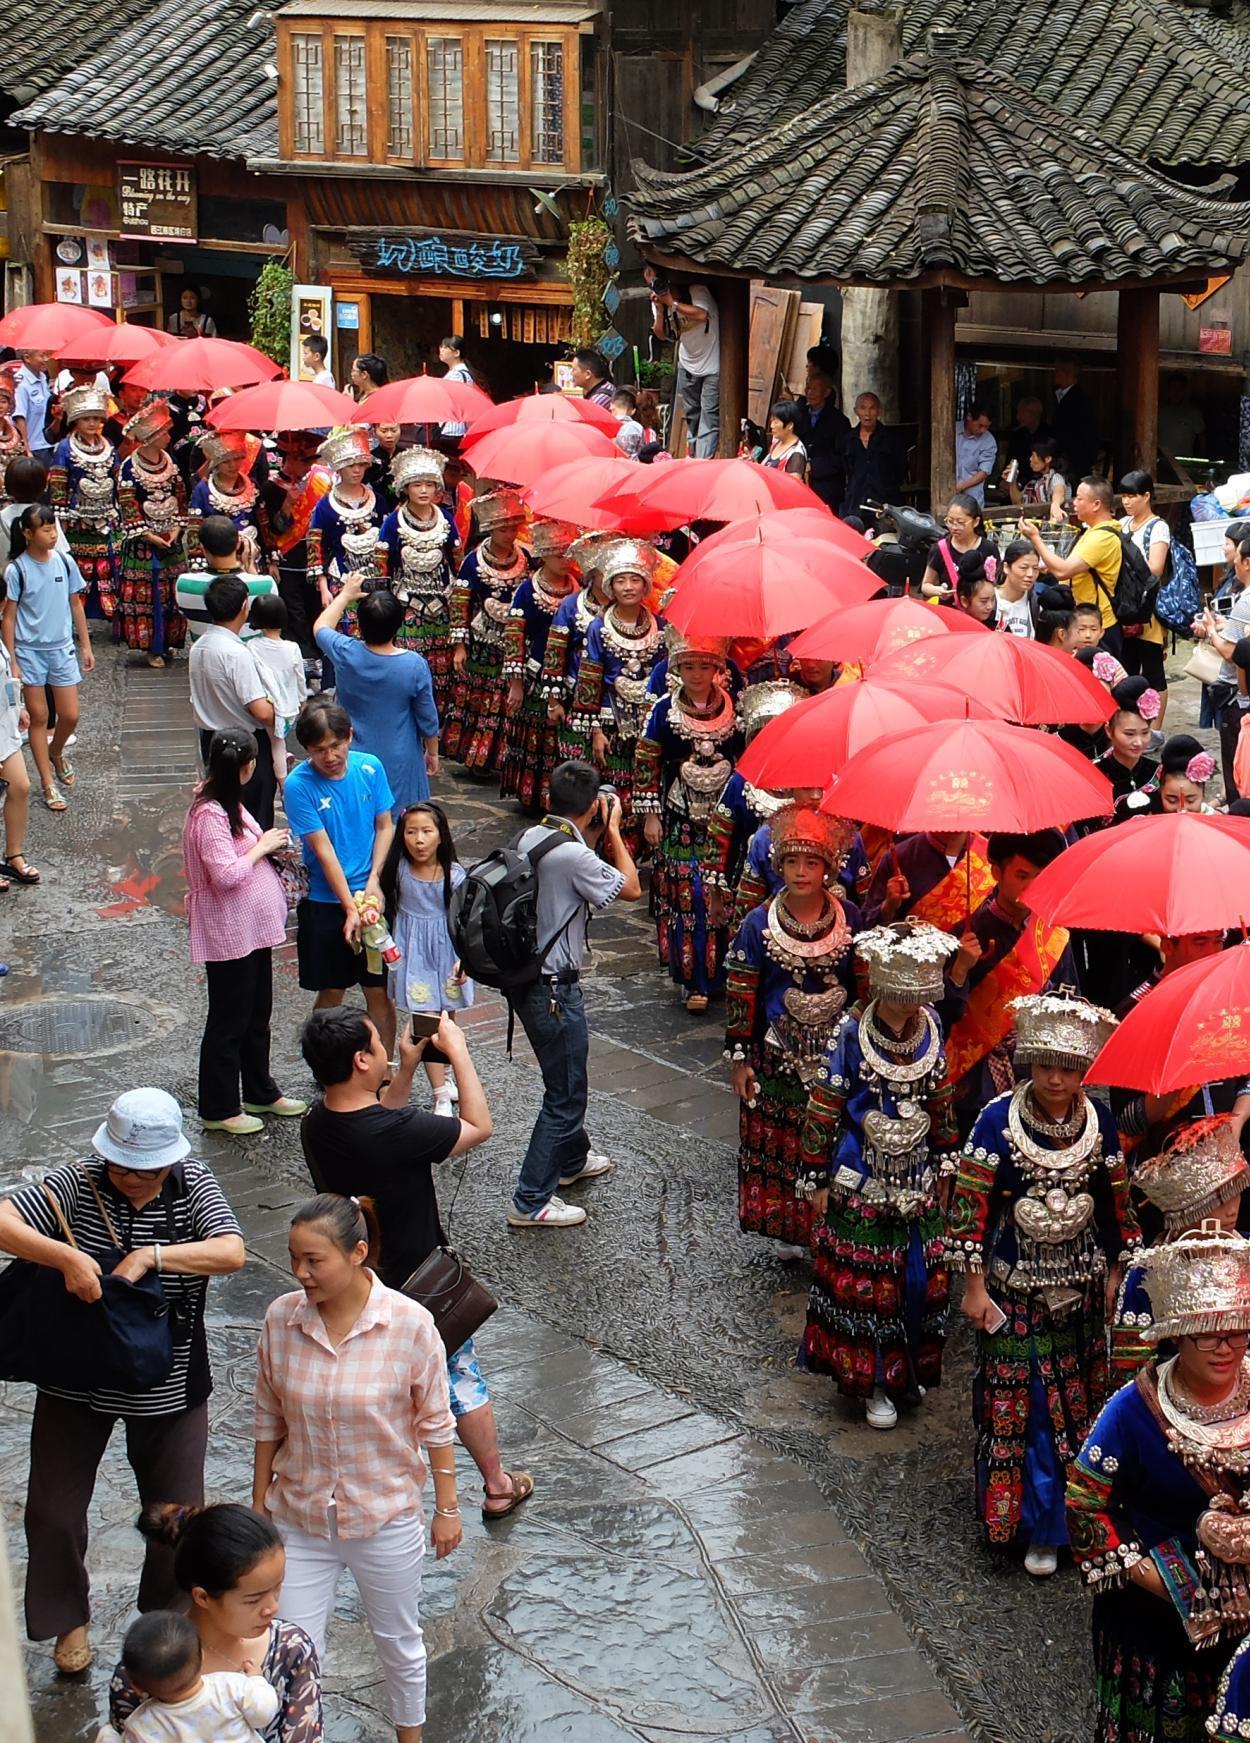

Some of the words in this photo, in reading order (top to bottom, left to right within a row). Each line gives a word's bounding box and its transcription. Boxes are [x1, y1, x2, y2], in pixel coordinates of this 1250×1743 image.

[123, 168, 190, 192] 一路花开
[123, 202, 148, 217] 特产
[375, 237, 525, 278] 现酿酸奶
